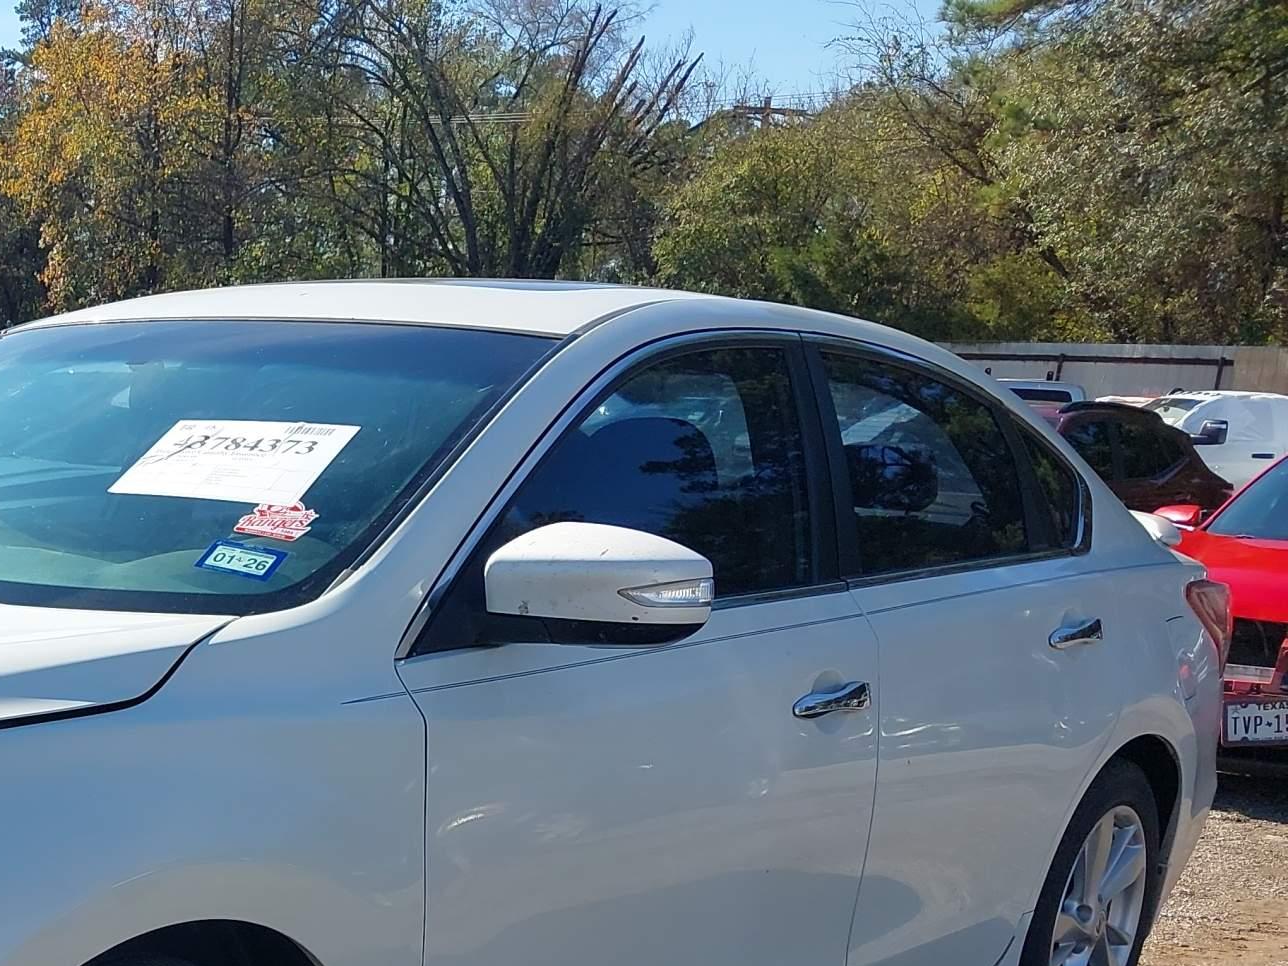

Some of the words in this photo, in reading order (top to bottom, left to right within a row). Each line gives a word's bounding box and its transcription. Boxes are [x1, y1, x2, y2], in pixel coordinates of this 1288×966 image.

[173, 435, 318, 455] 43784373
[240, 515, 309, 530] Rangers
[213, 552, 237, 565] 01
[243, 558, 269, 571] 26
[1256, 701, 1288, 711] TEXA
[1274, 714, 1288, 734] 1
